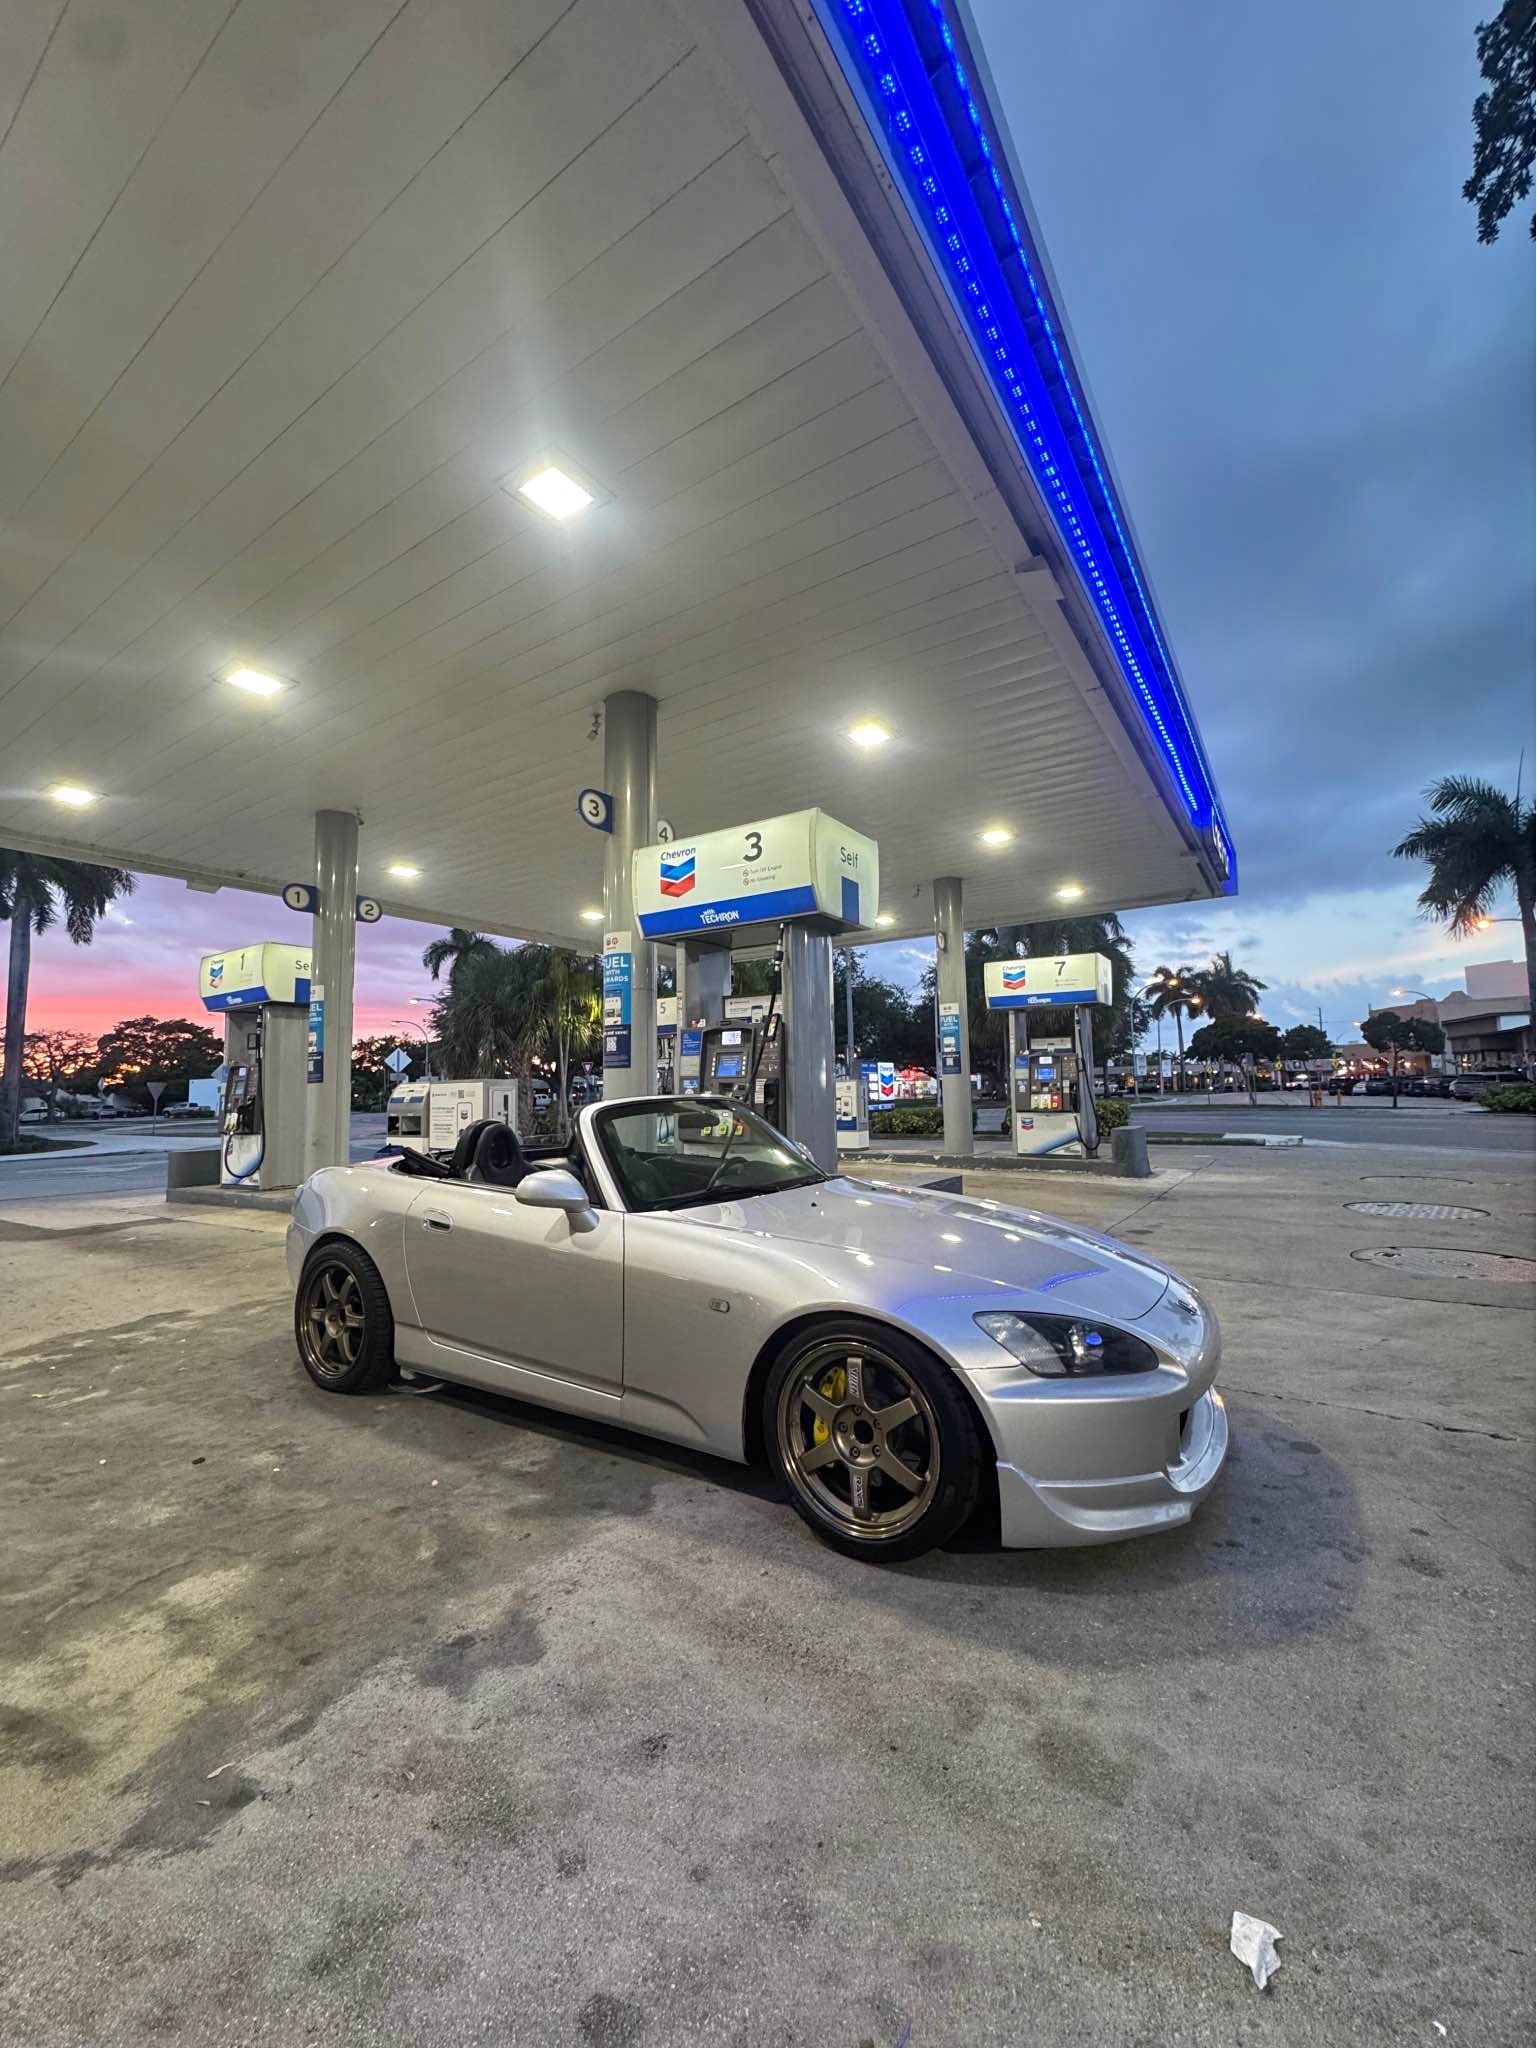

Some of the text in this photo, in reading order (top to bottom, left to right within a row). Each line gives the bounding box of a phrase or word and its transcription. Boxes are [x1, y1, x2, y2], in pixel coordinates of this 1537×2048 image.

[588, 799, 600, 818] 3
[658, 826, 669, 843] 4
[660, 847, 696, 861] Chevron
[743, 832, 763, 862] 3
[840, 846, 859, 869] Self
[294, 891, 301, 904] 1
[363, 903, 375, 916] 2
[699, 910, 739, 925] TECHRON
[240, 953, 245, 971] 1
[1054, 961, 1066, 976] 7
[660, 1002, 666, 1014] 5
